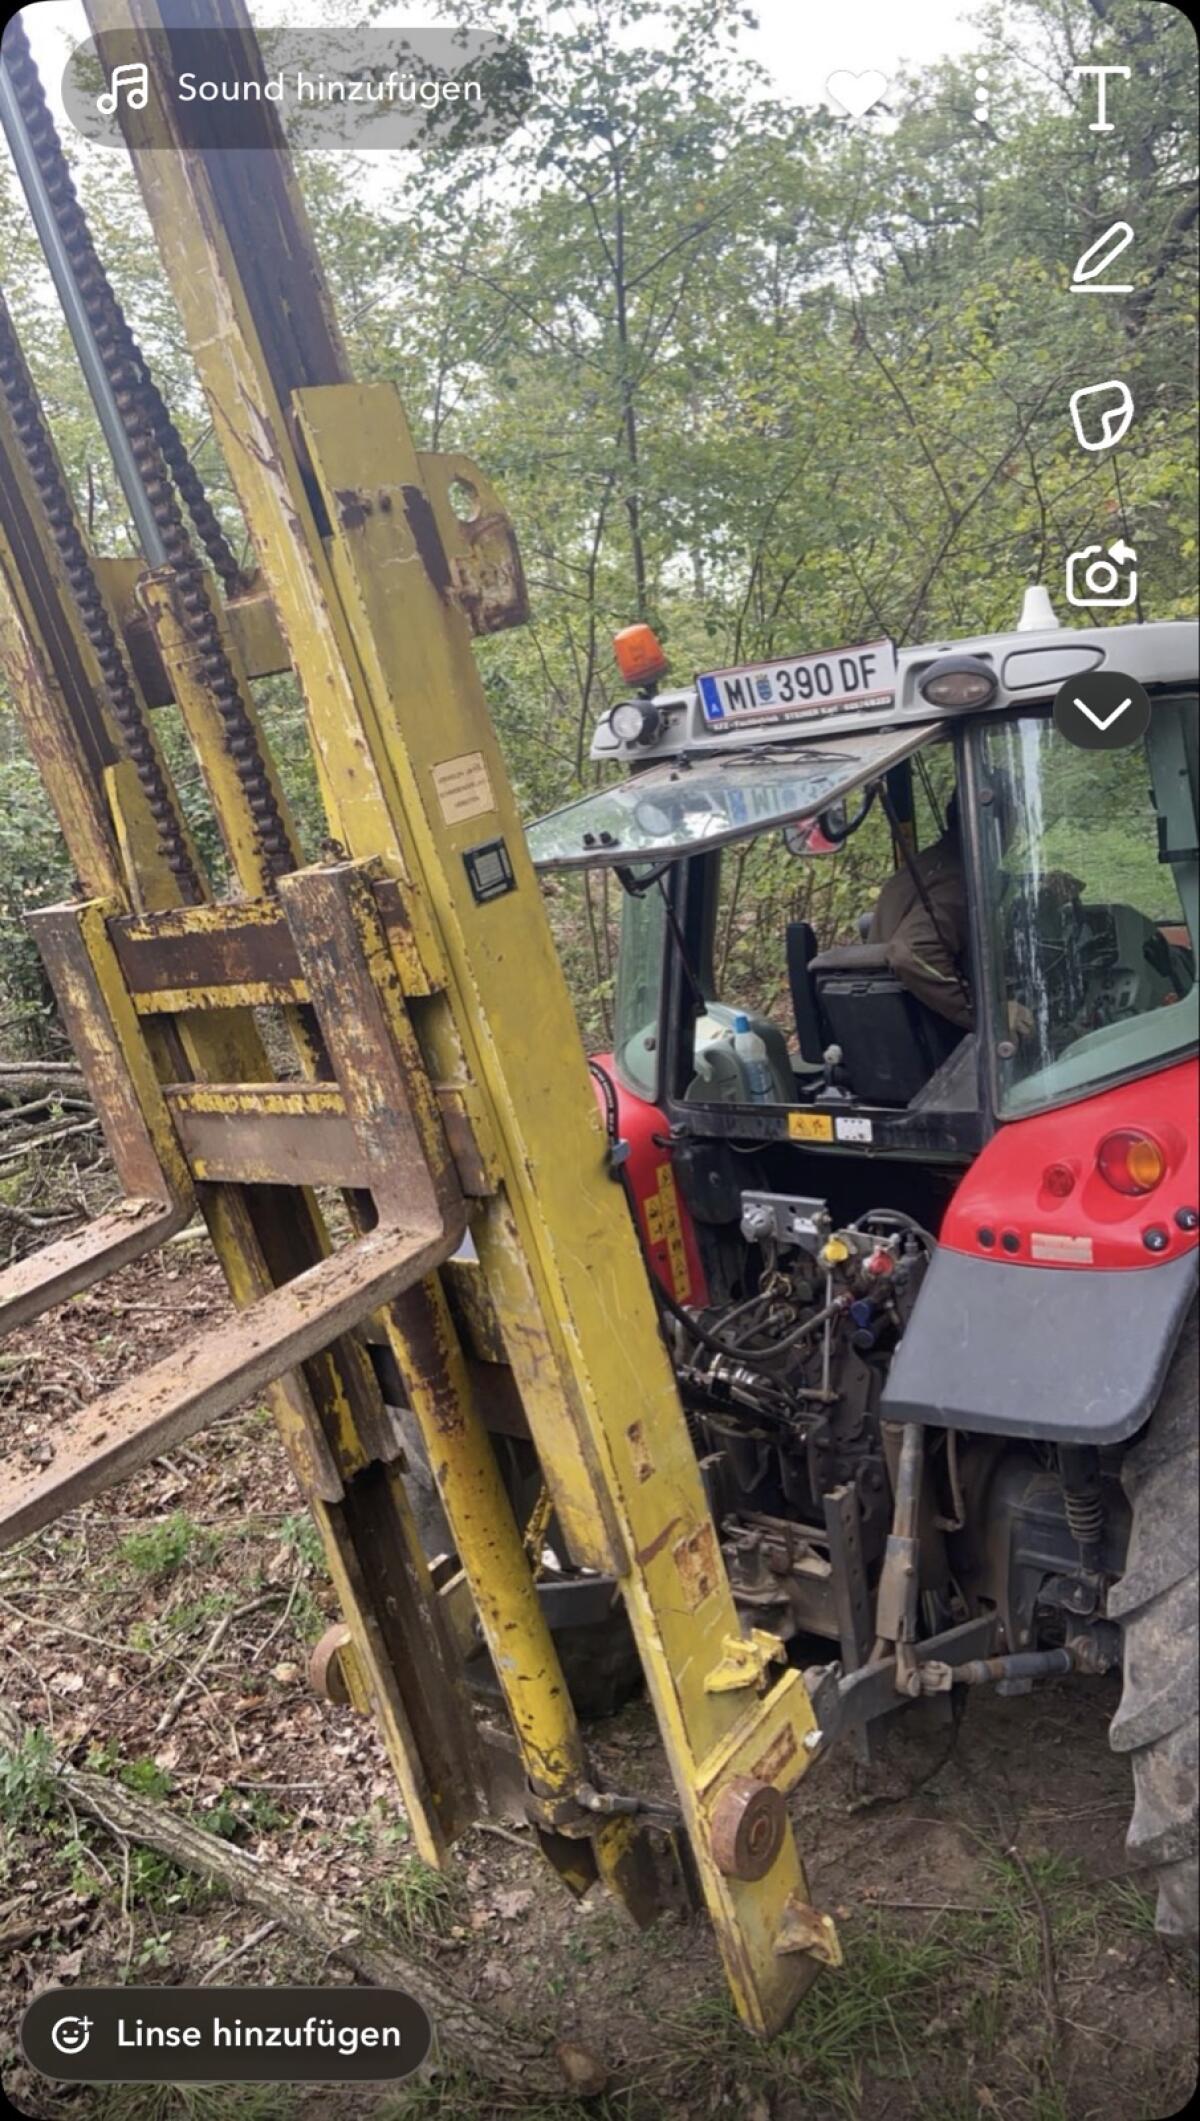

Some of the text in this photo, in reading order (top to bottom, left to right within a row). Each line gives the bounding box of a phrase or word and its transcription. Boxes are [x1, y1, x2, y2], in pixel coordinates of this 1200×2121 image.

[723, 653, 876, 711] MI 390 DF
